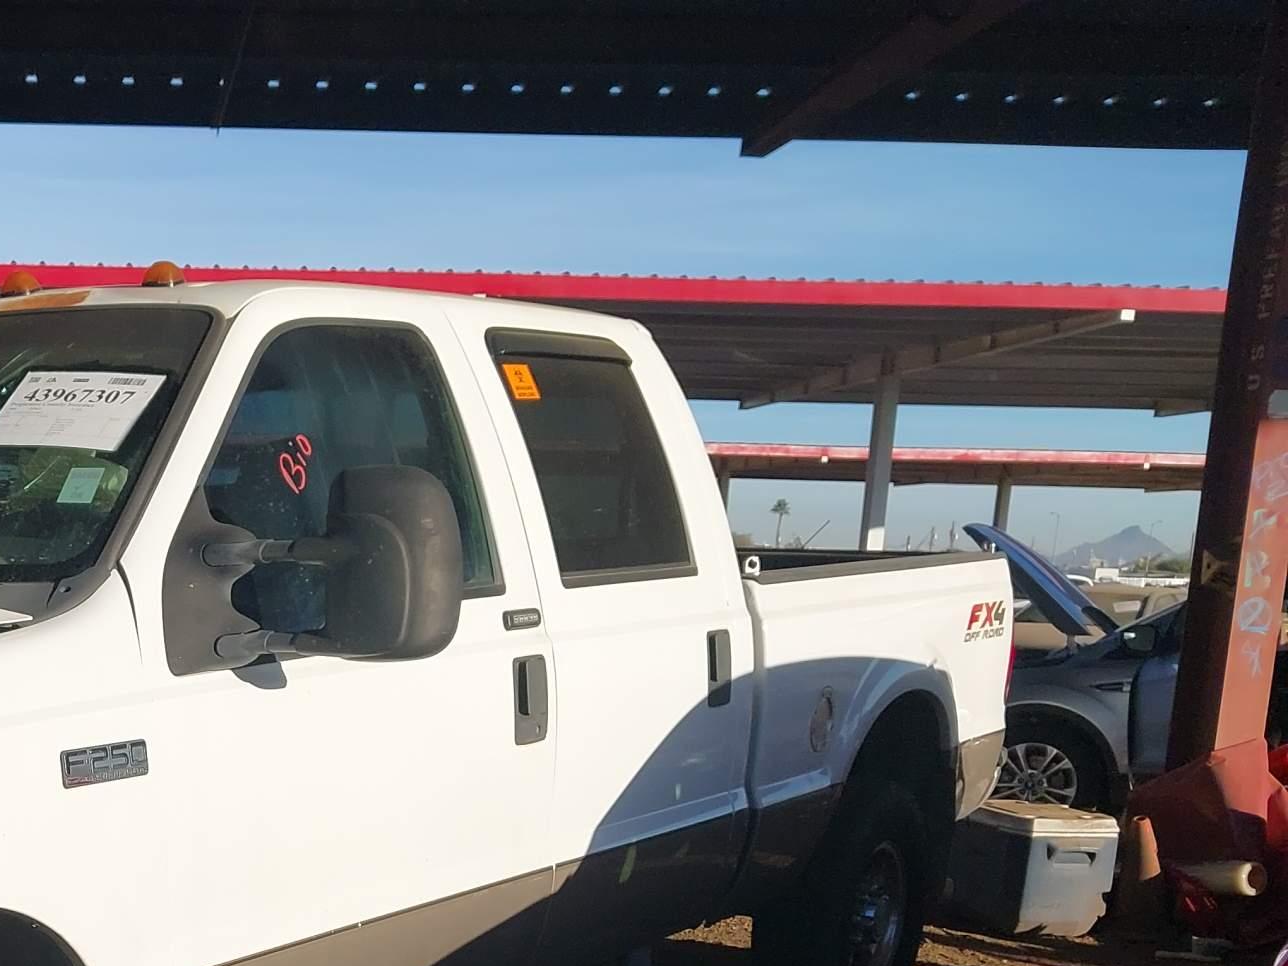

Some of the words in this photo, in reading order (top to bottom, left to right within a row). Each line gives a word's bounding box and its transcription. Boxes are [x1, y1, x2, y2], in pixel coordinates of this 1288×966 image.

[23, 388, 137, 404] 43967307
[967, 600, 1006, 630] FX4
[964, 631, 981, 642] OFF
[982, 627, 1004, 639] ROAD
